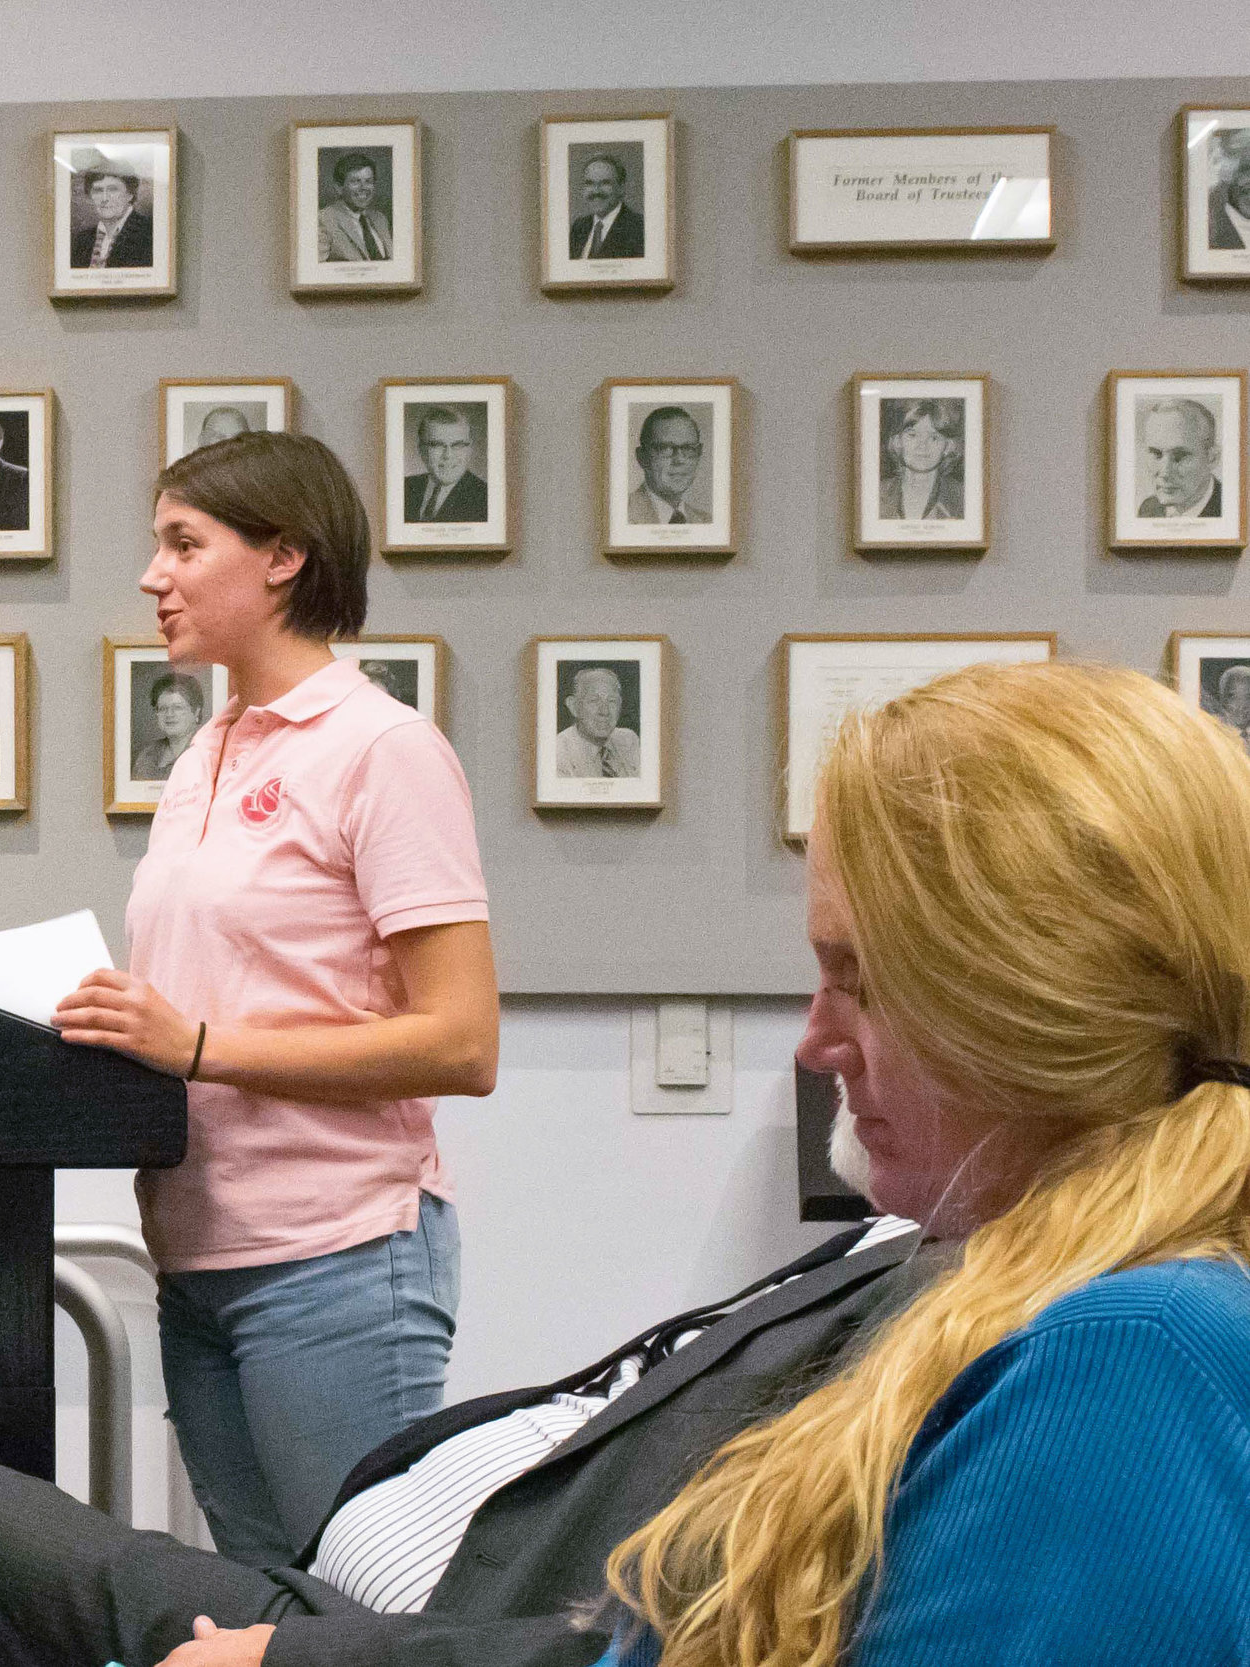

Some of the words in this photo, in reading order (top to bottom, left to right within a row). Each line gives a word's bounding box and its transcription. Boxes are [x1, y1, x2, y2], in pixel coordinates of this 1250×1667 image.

[834, 174, 883, 186] Former
[893, 171, 958, 185] Members
[966, 172, 982, 187] of
[856, 188, 899, 201] Board
[907, 188, 924, 205] of
